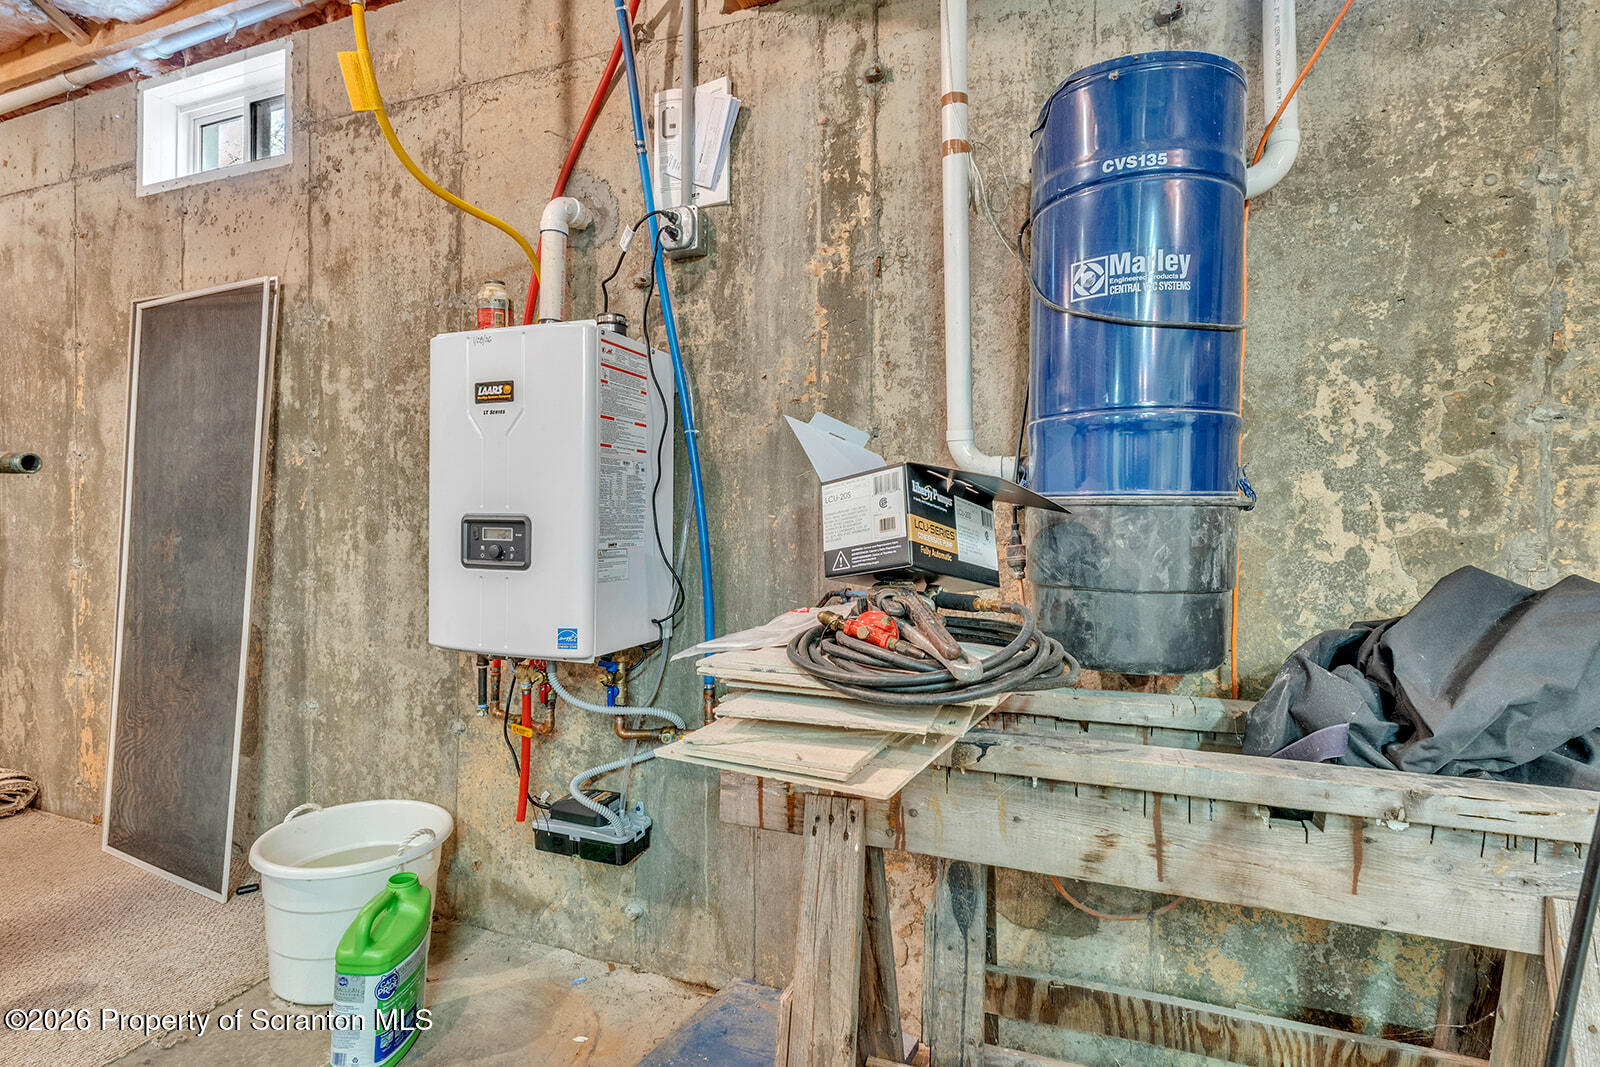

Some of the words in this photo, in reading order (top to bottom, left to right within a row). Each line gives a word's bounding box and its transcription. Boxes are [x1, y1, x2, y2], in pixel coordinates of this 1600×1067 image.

[1101, 152, 1168, 174] CVS135
[1109, 248, 1191, 279] Marley
[1109, 283, 1142, 295] CENTRAL
[1159, 280, 1191, 291] SYSTEMS
[1110, 275, 1147, 284] Engineered
[478, 384, 503, 396] LAARS
[912, 480, 933, 501] Liberty
[933, 488, 953, 508] Pumps
[914, 519, 955, 541] LCU-SERIES
[920, 545, 931, 557] Fully
[931, 548, 953, 562] Automatic
